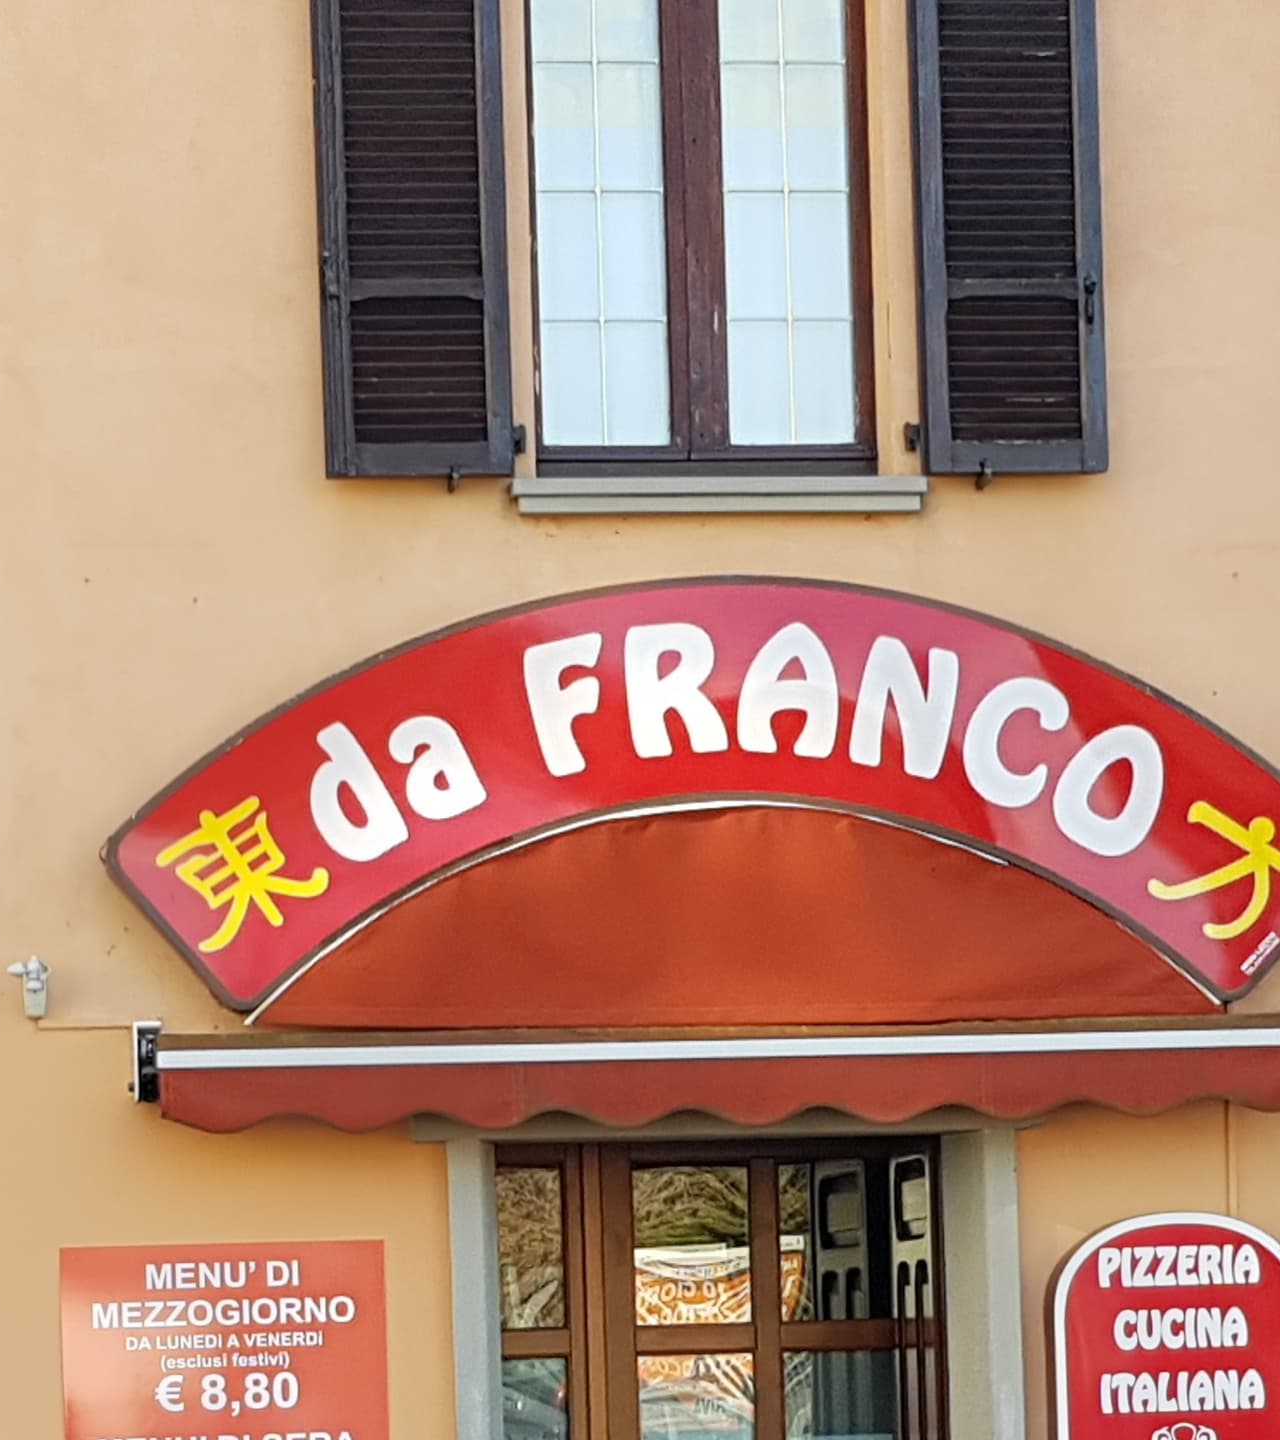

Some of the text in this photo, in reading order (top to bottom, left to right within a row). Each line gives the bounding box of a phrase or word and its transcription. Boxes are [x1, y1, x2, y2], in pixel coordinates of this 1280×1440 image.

[308, 622, 1164, 861] da FRANCO
[156, 795, 330, 953] 東
[267, 1260, 300, 1287] DI
[1098, 1244, 1260, 1288] PIZZERIA
[92, 1296, 355, 1329] MEZZOGIORNO
[1114, 1306, 1249, 1350] CUCINA
[125, 1336, 151, 1351] DA
[227, 1333, 240, 1348] A
[160, 1350, 290, 1373] (esclusi festivi)
[155, 1371, 299, 1416] € 8,80
[1100, 1368, 1265, 1414] ITALIANA
